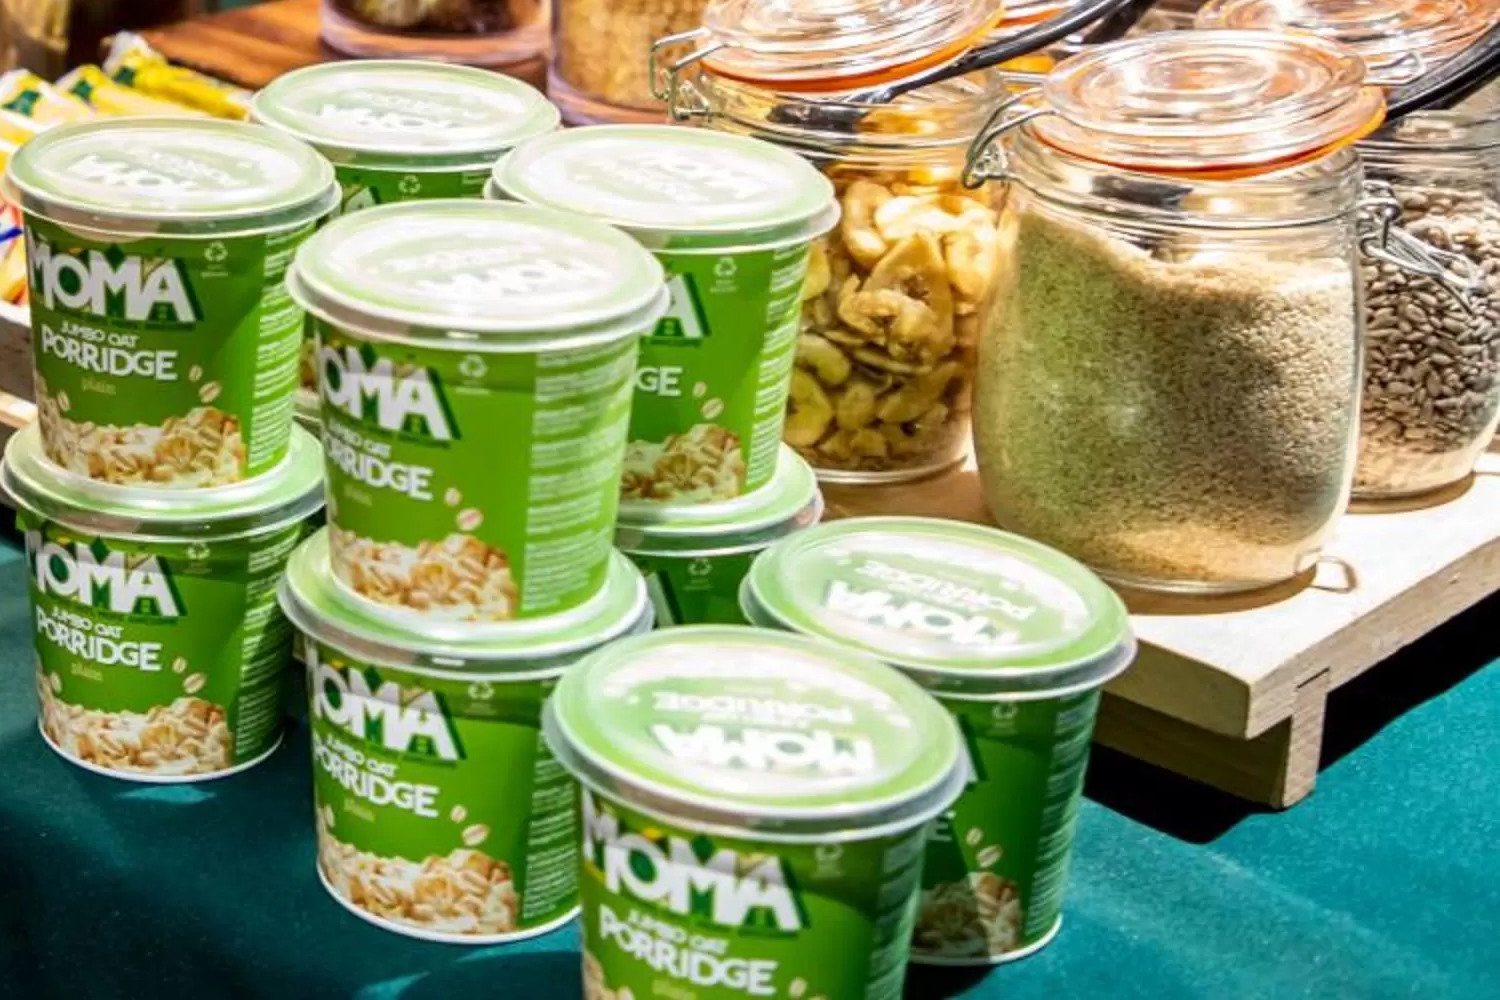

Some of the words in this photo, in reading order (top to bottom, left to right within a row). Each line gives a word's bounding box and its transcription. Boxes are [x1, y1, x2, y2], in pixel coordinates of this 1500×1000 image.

[41, 323, 178, 380] PORRIDGE
[314, 340, 452, 441] OMA
[36, 604, 163, 672] PORRIDGE
[583, 788, 801, 931] MOMA
[600, 904, 779, 996] PORRIDGE
